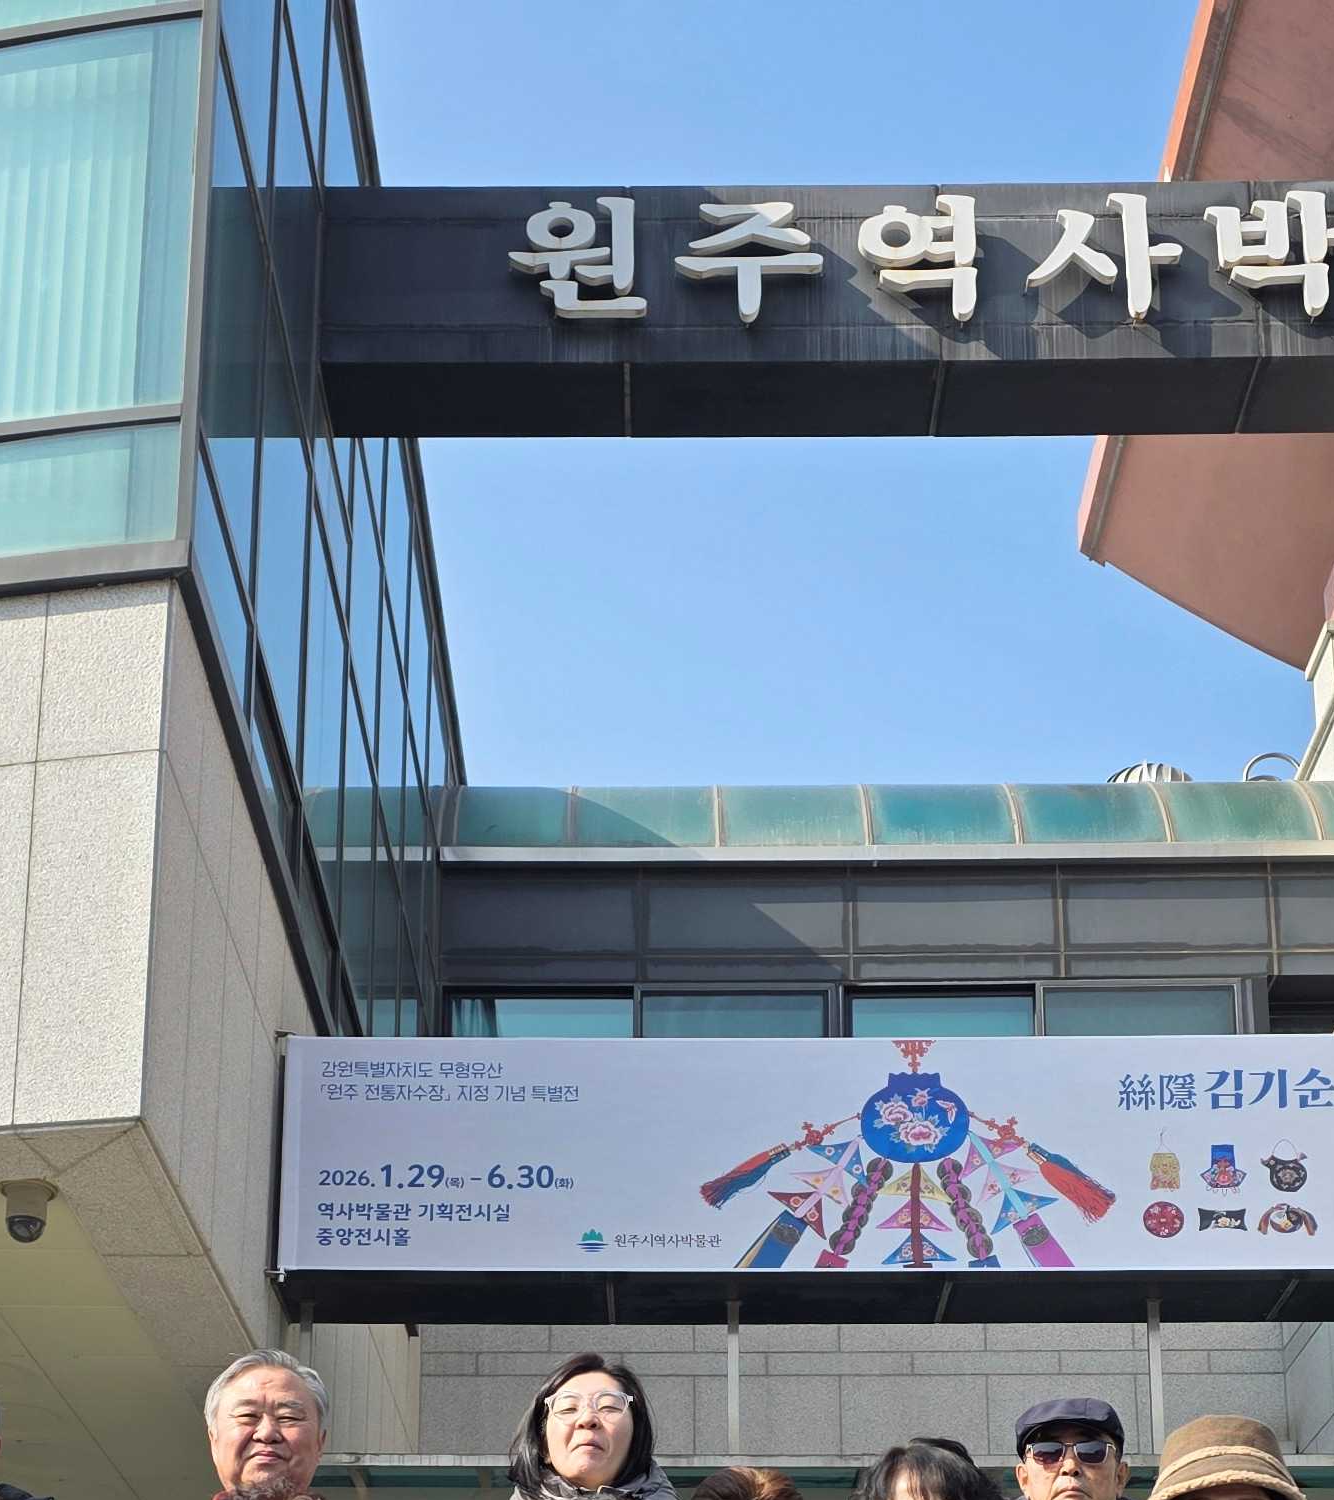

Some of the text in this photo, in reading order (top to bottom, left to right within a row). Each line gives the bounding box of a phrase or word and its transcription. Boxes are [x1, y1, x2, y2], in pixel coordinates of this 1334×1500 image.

[322, 1061, 504, 1080] 강원특별자치도 무형유산
[457, 1085, 490, 1102] 지정
[496, 1086, 527, 1103] 기념
[532, 1086, 580, 1103] 특별전
[317, 1202, 512, 1223] 역사박물관 기획전시실
[316, 1227, 412, 1248] 중앙전시홀
[614, 1233, 723, 1249] 원주시역사박물관
